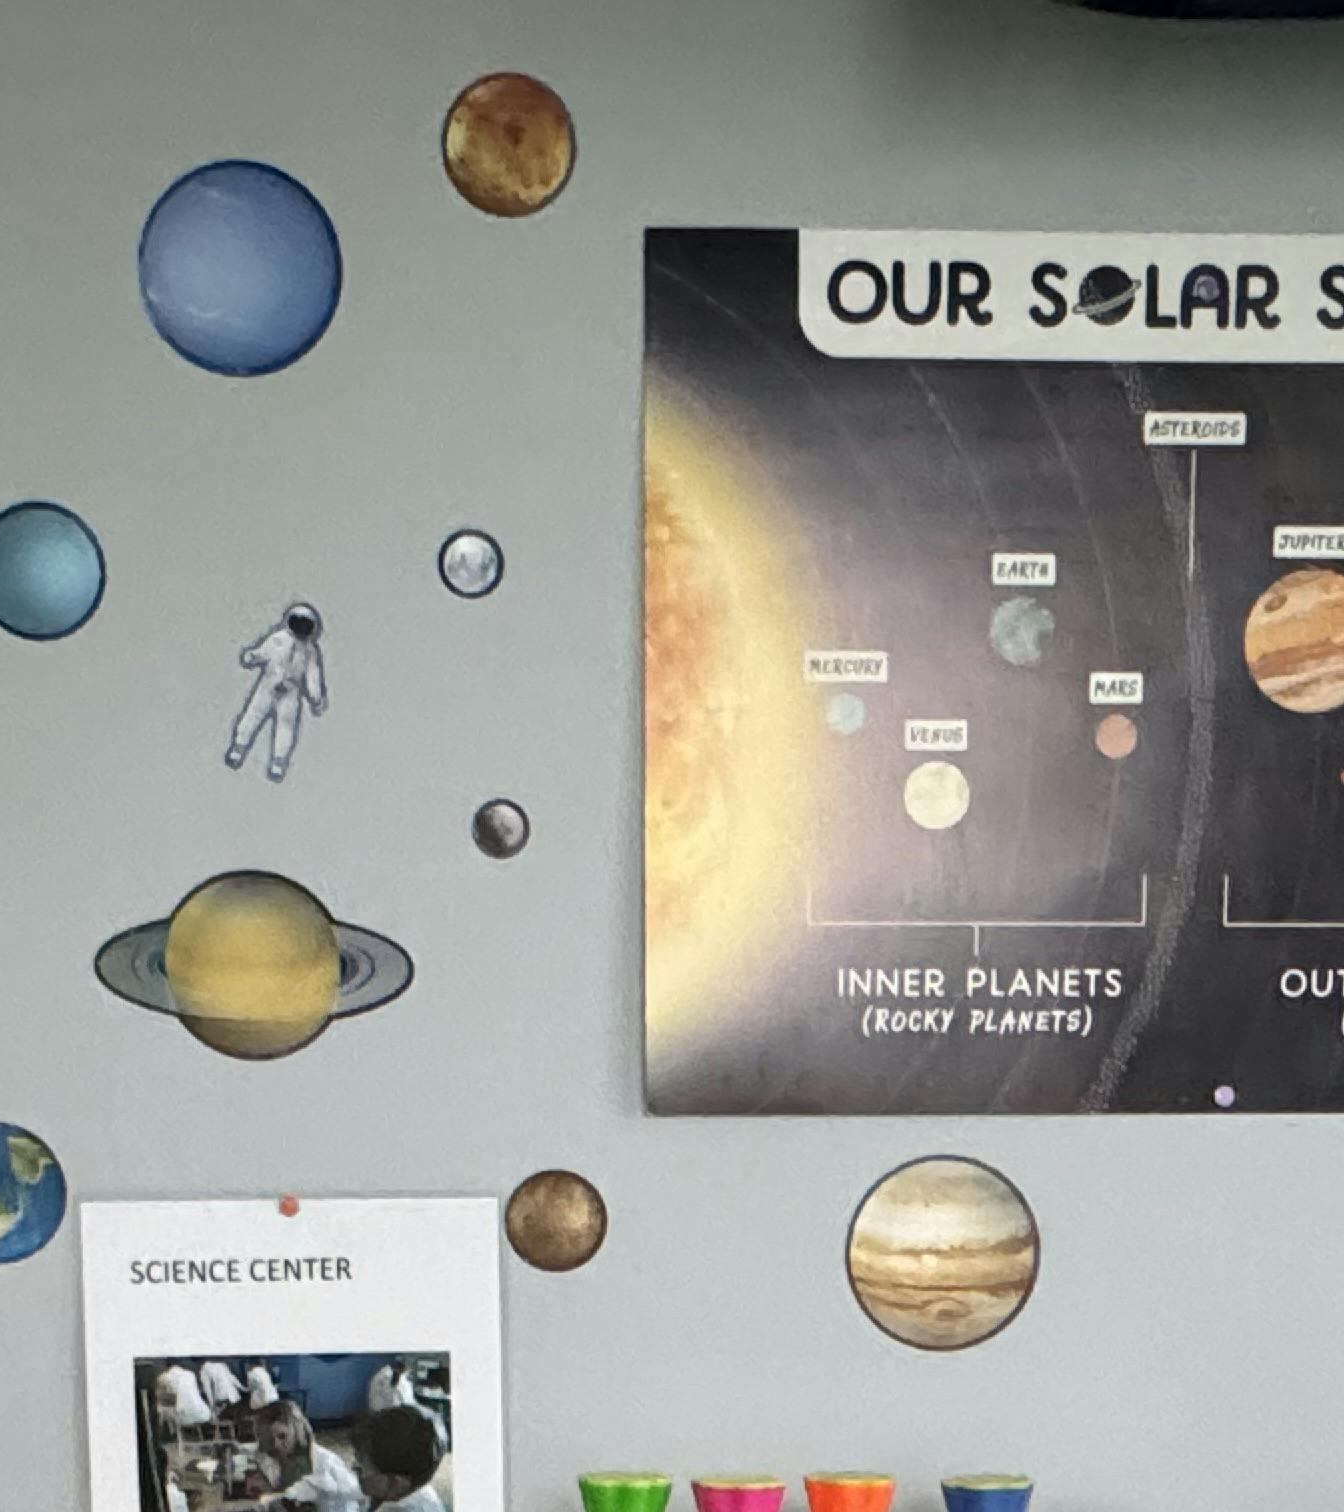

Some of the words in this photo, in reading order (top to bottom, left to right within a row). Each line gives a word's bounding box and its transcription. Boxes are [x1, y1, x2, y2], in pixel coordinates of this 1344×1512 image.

[827, 259, 992, 326] OUR
[1028, 262, 1280, 328] SOLAR
[1148, 419, 1241, 440] ASTEROIDS
[996, 561, 1049, 580] EARTH
[809, 657, 884, 676] MERCURY
[1093, 678, 1139, 698] MARS
[909, 726, 965, 745] VENUS
[836, 967, 946, 998] INNER
[966, 967, 1123, 998] PLANETS
[861, 1003, 955, 1038] (ROCKY
[969, 1003, 1094, 1038] PLANETS)
[130, 1259, 242, 1285] SCIENCE
[250, 1256, 353, 1282] CENTER
